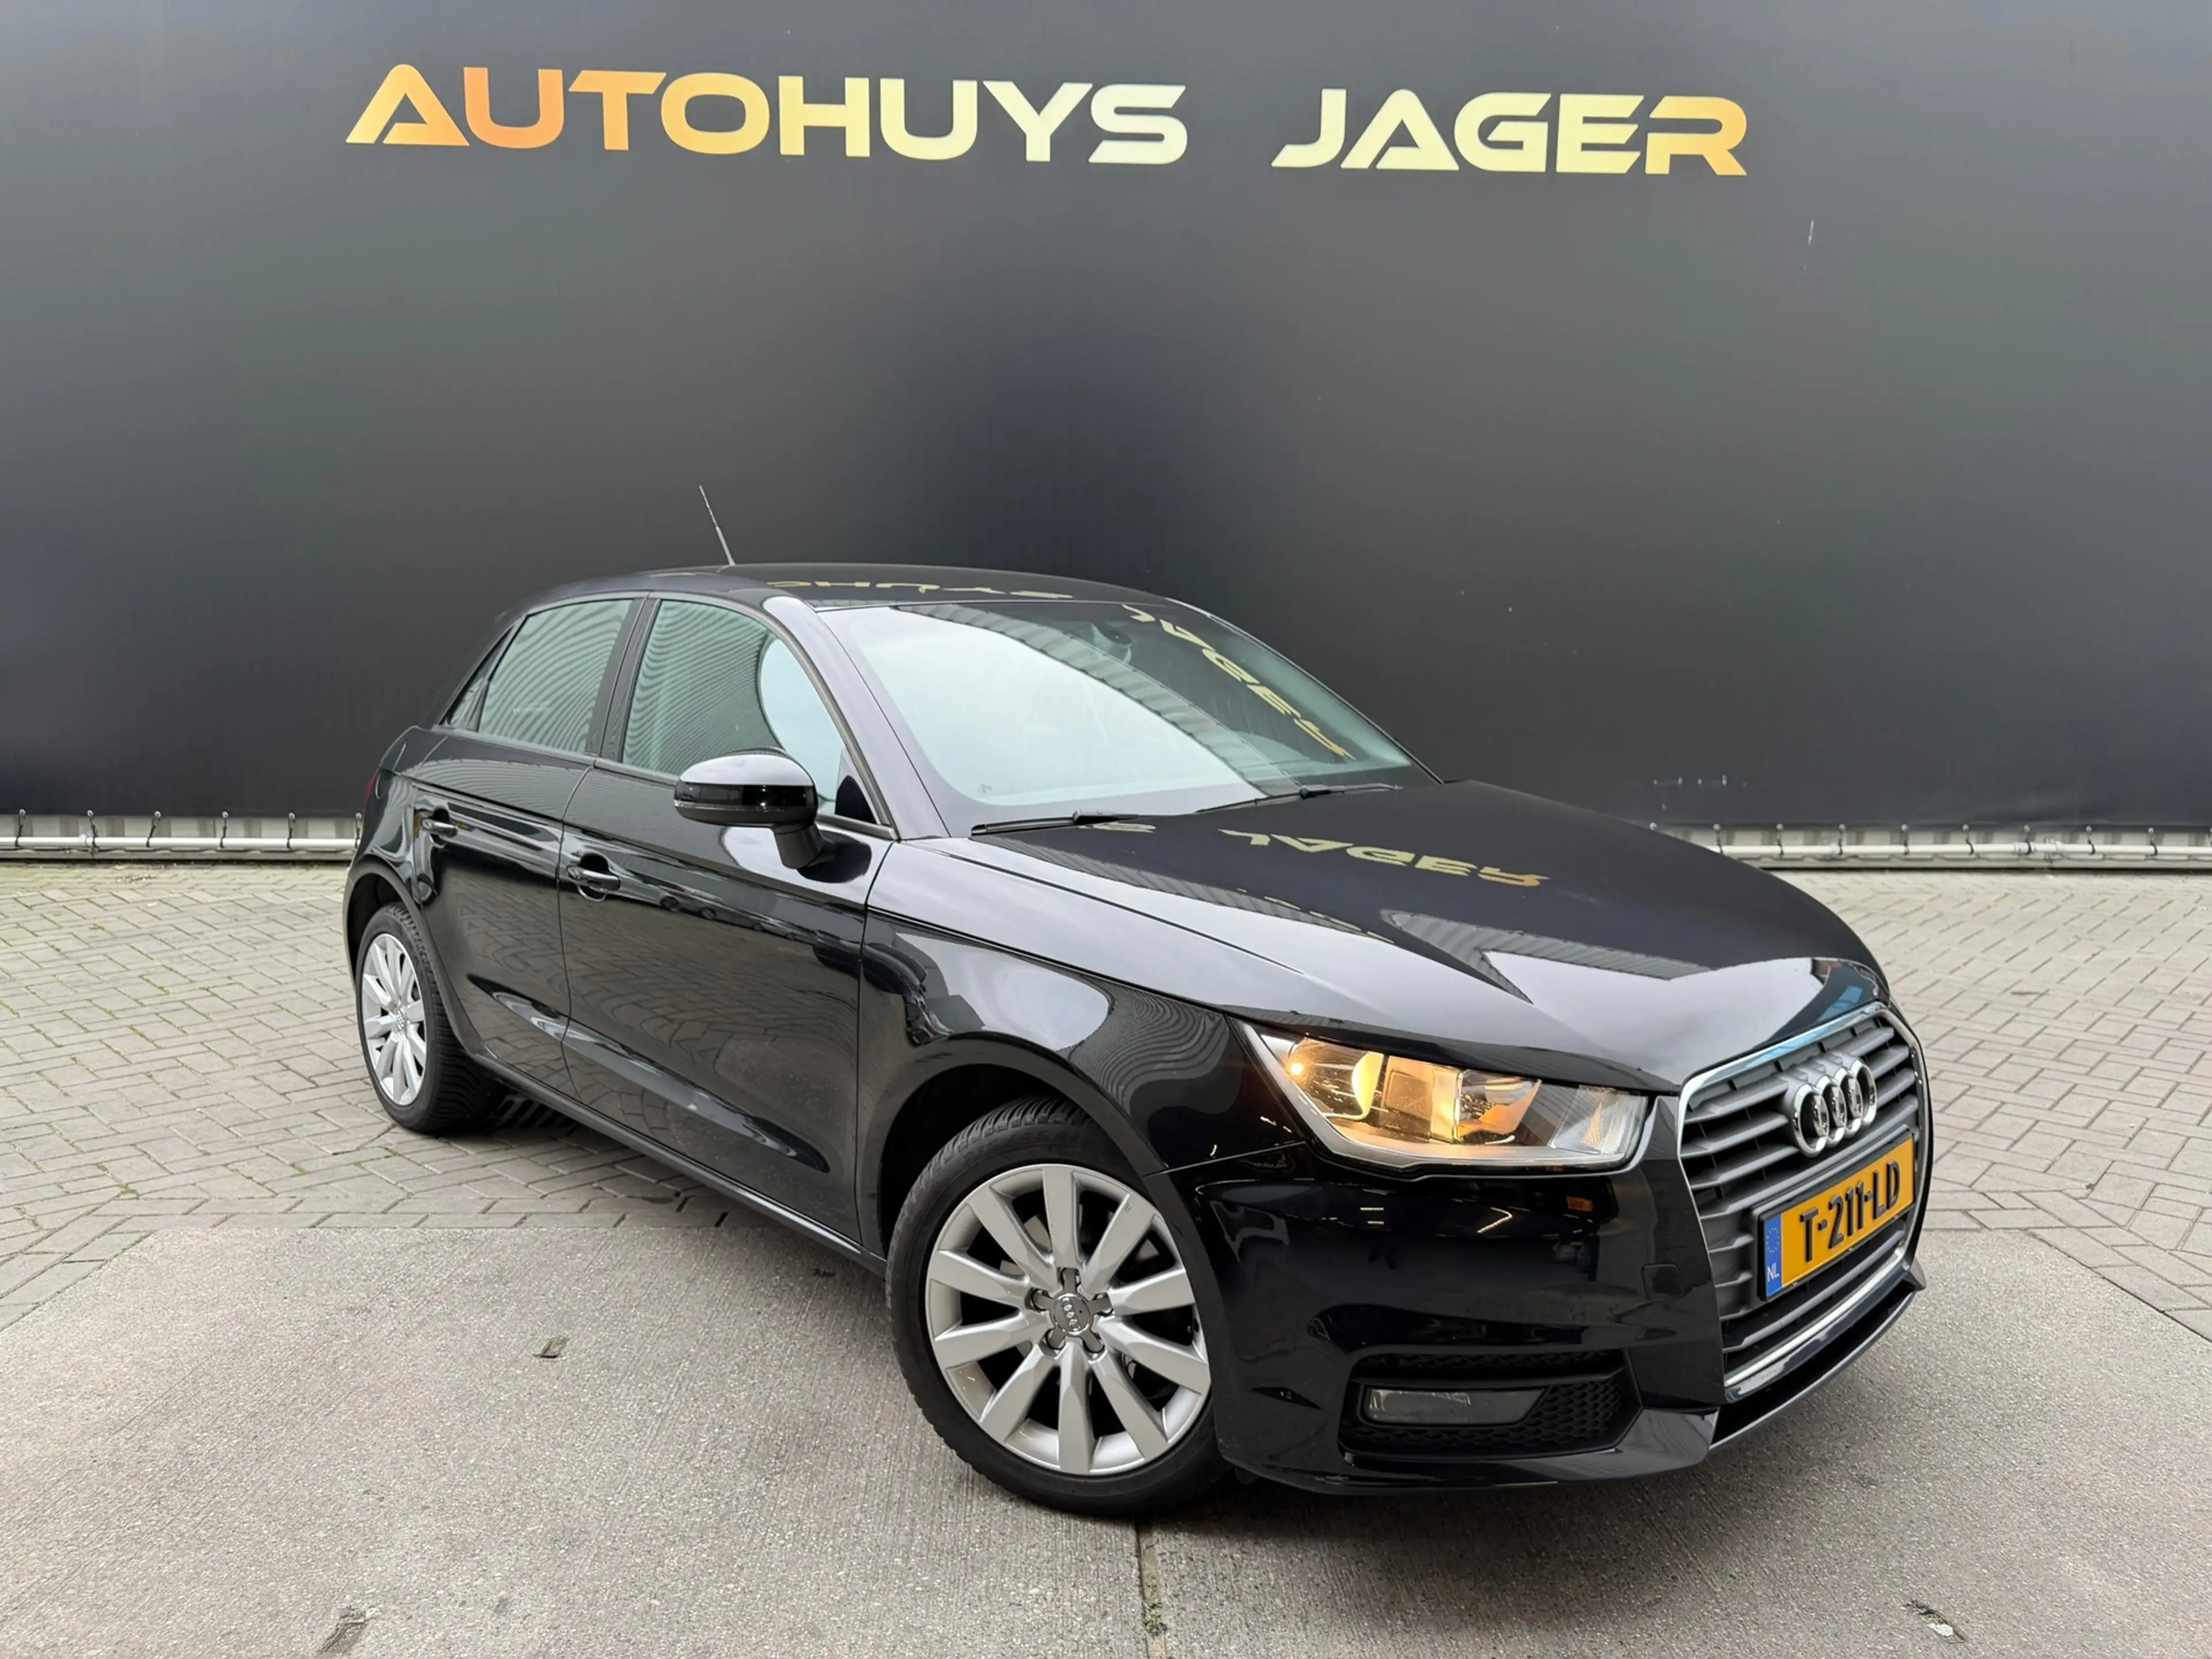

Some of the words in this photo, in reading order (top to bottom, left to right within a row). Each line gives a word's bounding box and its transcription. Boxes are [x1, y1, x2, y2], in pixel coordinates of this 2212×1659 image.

[346, 63, 1188, 165] AUTOHUYS
[1271, 89, 1748, 176] JAGER
[1800, 1160, 1901, 1263] T-211-LD
[1767, 1262, 1780, 1282] NL
